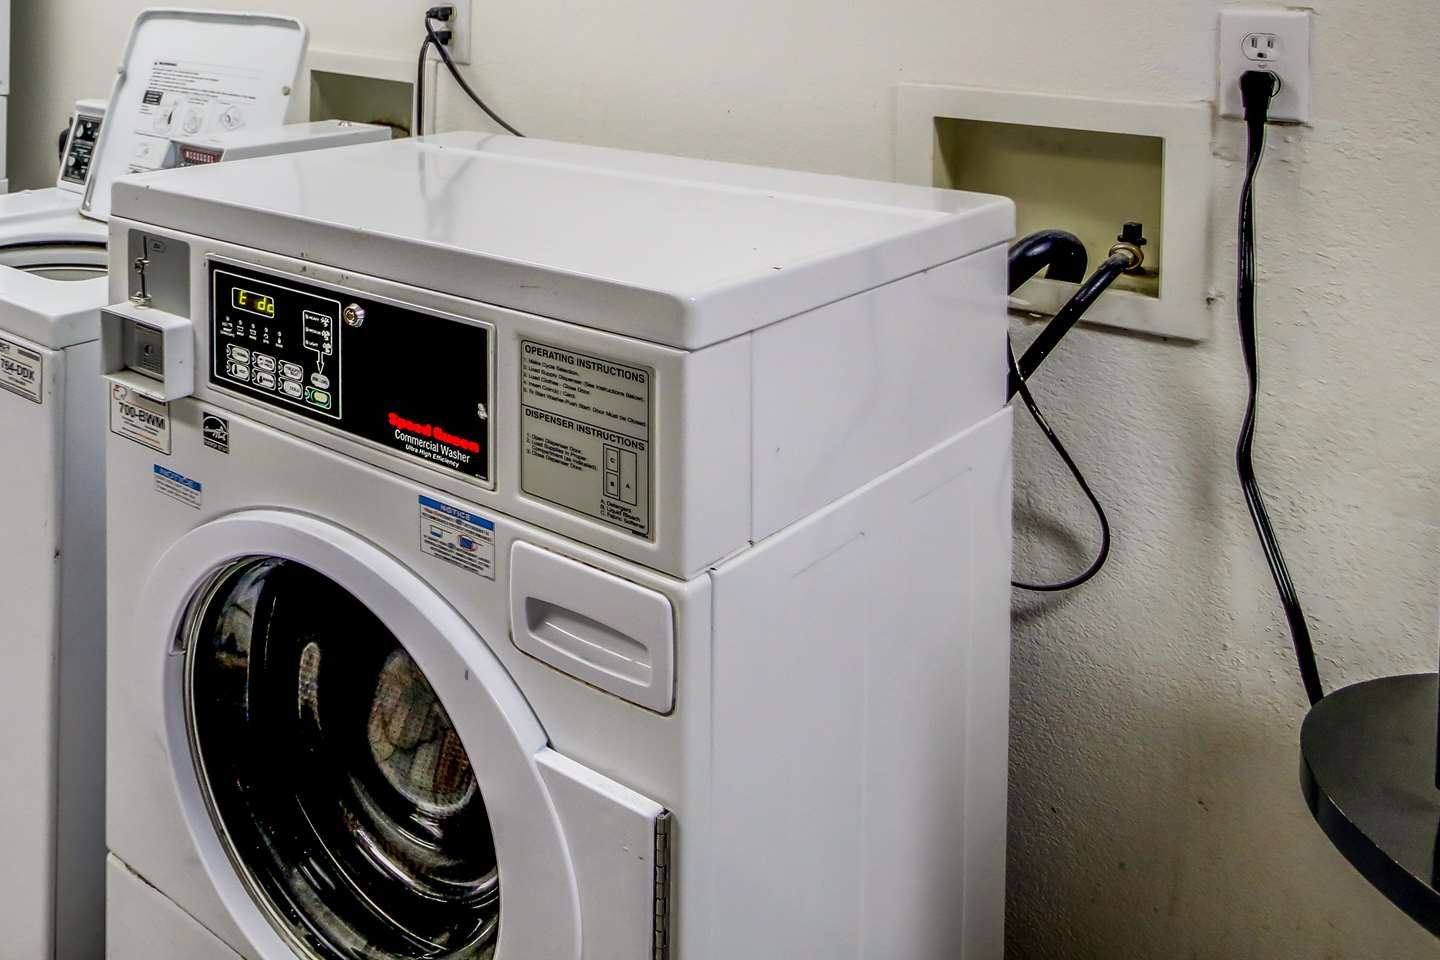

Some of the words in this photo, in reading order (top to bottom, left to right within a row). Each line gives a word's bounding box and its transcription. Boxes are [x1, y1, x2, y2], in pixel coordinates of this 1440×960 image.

[524, 344, 575, 365] OPERATING
[576, 358, 645, 383] INSTRUCTIONS
[394, 429, 439, 452] Commercial
[440, 444, 471, 464] Washer
[525, 408, 574, 430] DISPENSER
[576, 423, 645, 451] INSTRUCTIONS
[405, 444, 419, 453] Ultra
[419, 449, 432, 459] High
[432, 453, 460, 468] Efficiency
[440, 504, 472, 521] NOTICE
